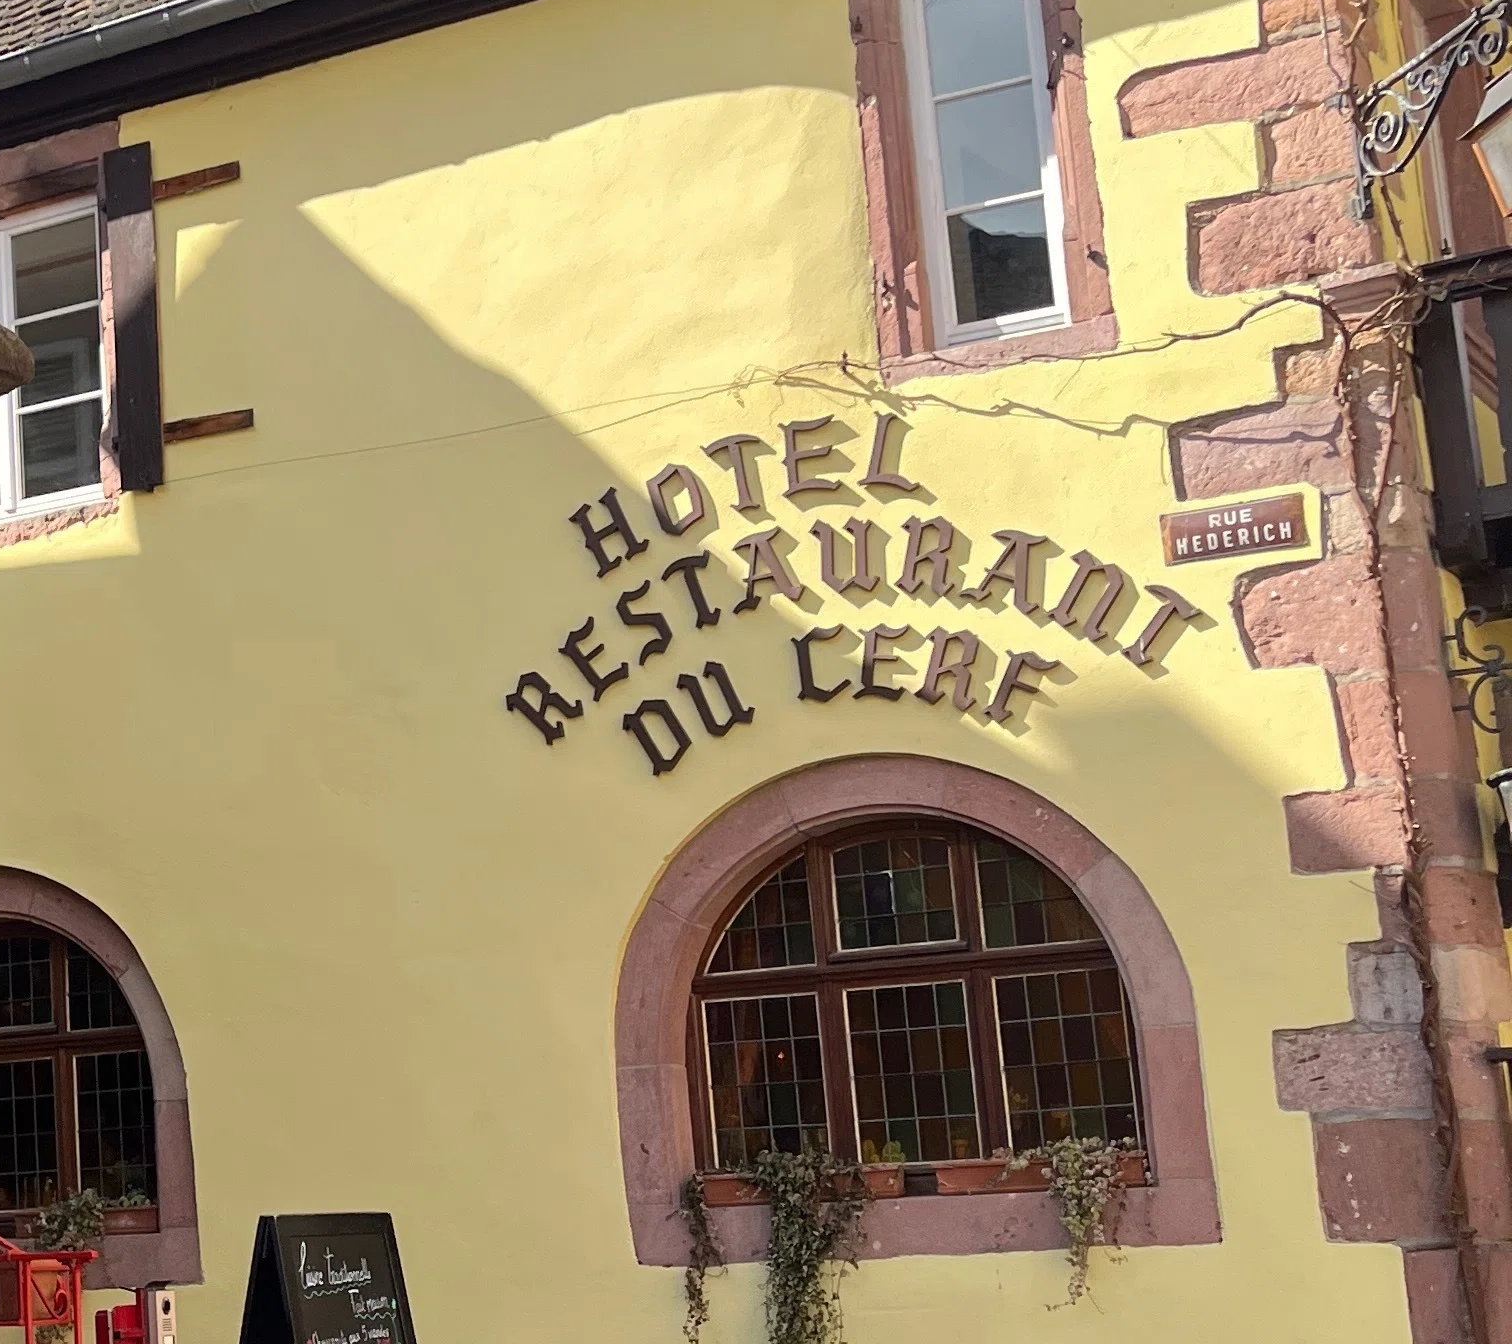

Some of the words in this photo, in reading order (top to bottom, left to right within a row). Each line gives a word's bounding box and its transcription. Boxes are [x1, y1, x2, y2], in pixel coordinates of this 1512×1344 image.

[568, 411, 921, 579] HOTEL
[1175, 521, 1292, 556] HEDERICH
[1208, 508, 1253, 529] RUE
[506, 515, 1202, 746] RESTAURANT
[622, 660, 756, 777] DU
[791, 622, 1062, 724] CERF
